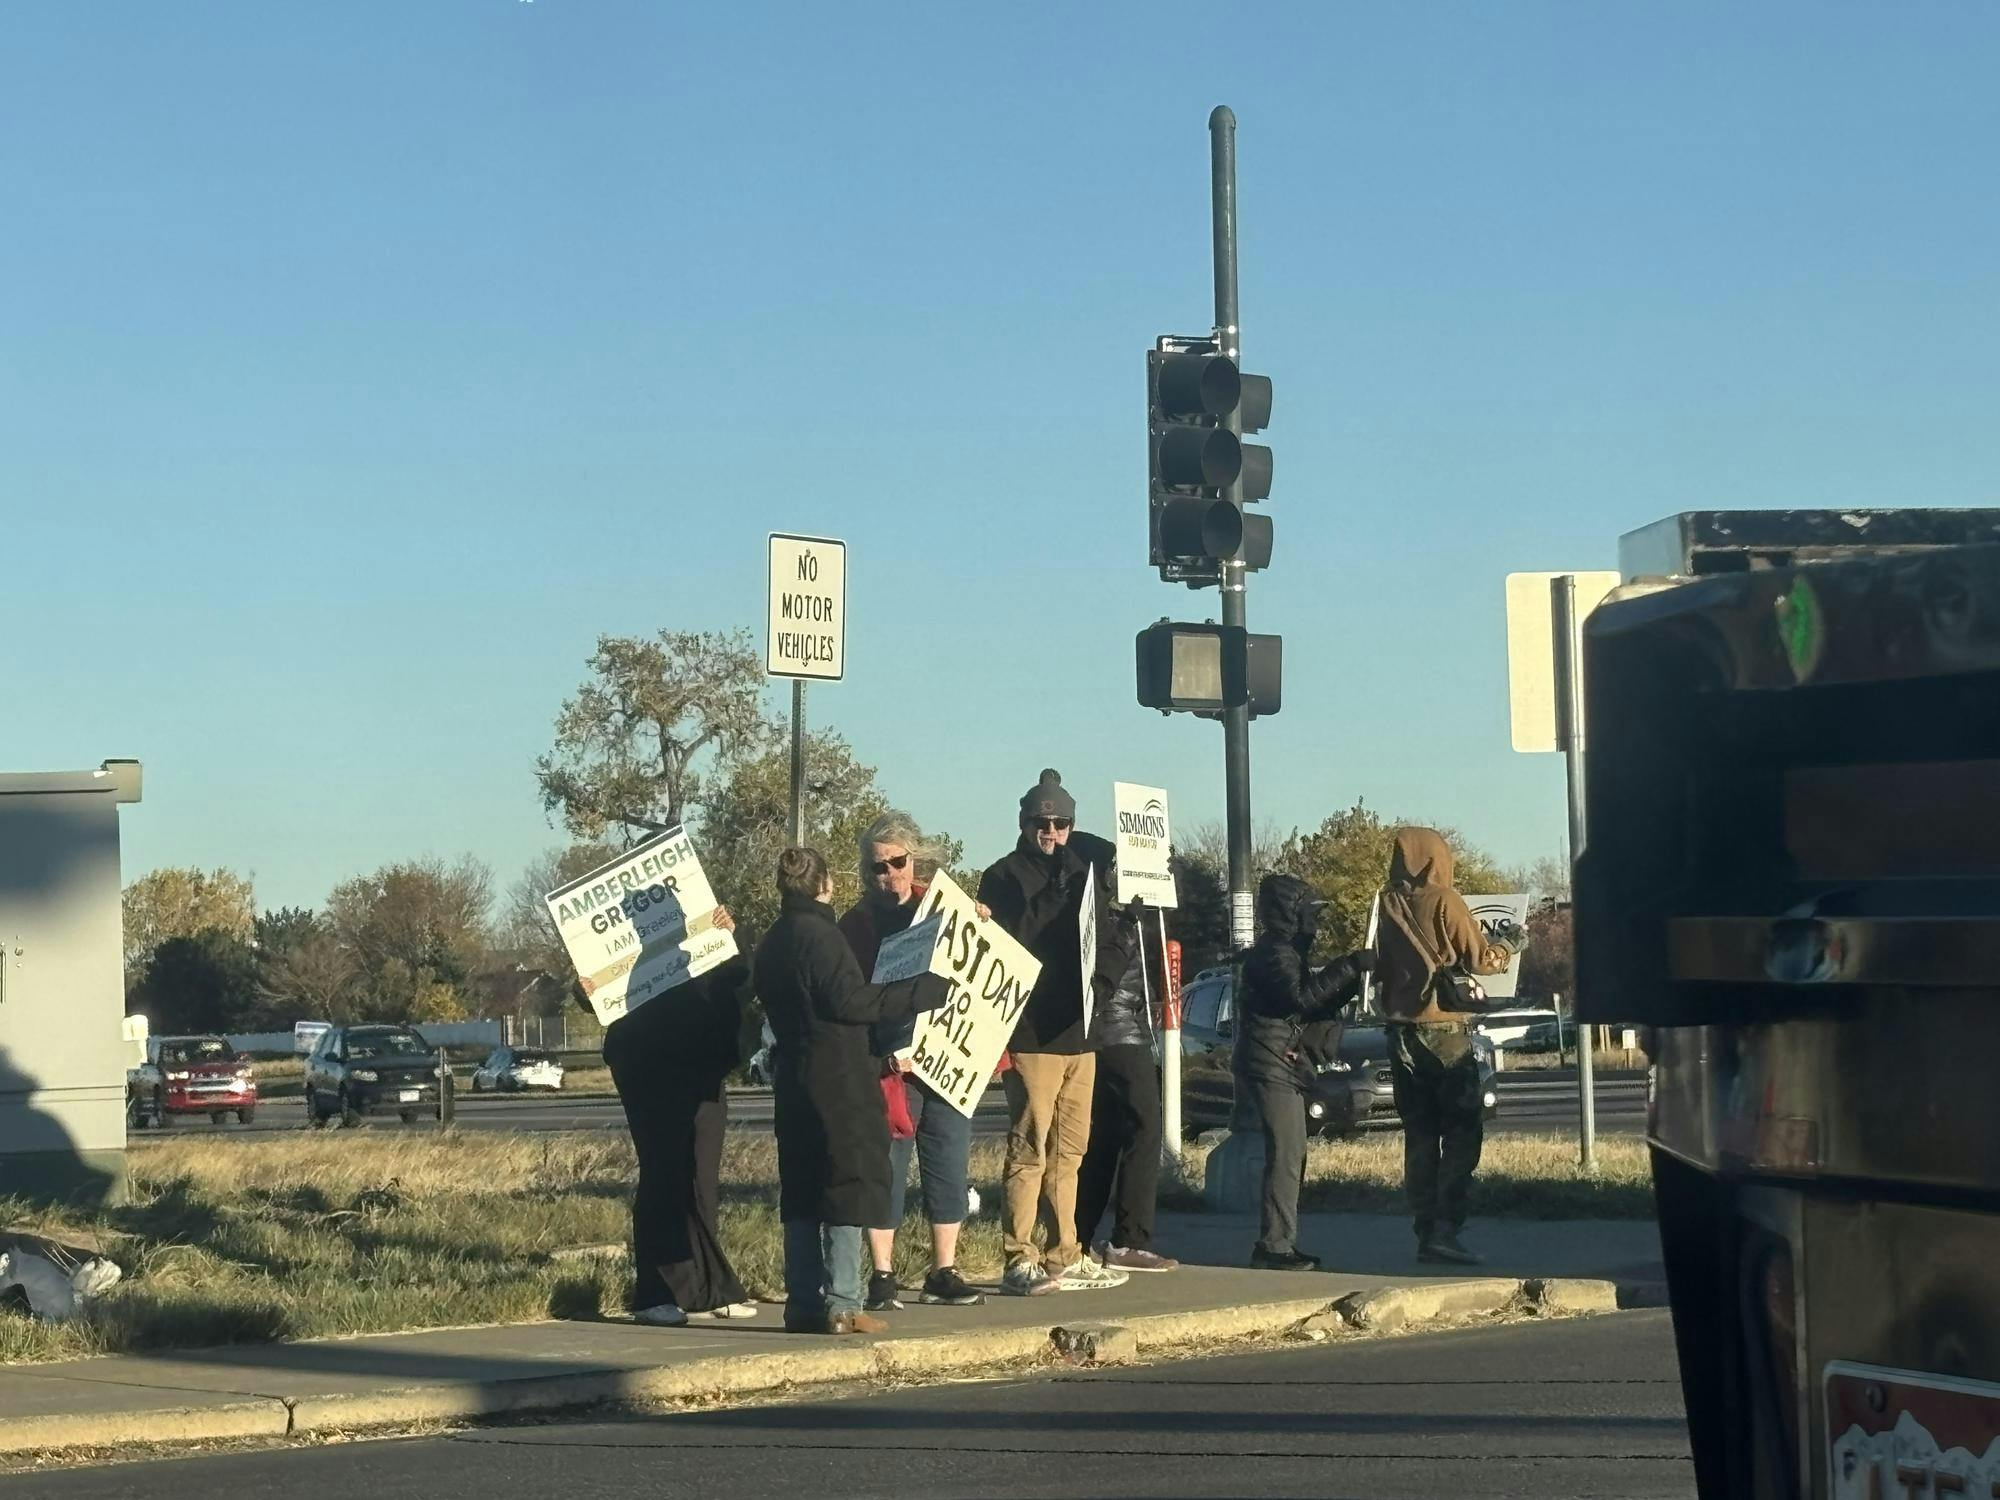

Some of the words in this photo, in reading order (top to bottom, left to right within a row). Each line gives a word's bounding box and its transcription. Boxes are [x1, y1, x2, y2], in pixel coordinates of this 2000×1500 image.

[798, 554, 818, 582] NO
[782, 592, 833, 622] MOTOR
[777, 632, 834, 662] VEHICLES
[1119, 811, 1165, 839] SIMMONS
[558, 838, 694, 926] AMBERLEIGH
[591, 875, 681, 934] GREGOR
[605, 943, 612, 956] I
[613, 931, 636, 953] AM
[947, 976, 971, 1016] TO
[981, 958, 1031, 1025] DAY
[928, 1004, 975, 1057] AIL
[912, 1034, 978, 1106] ballot!
